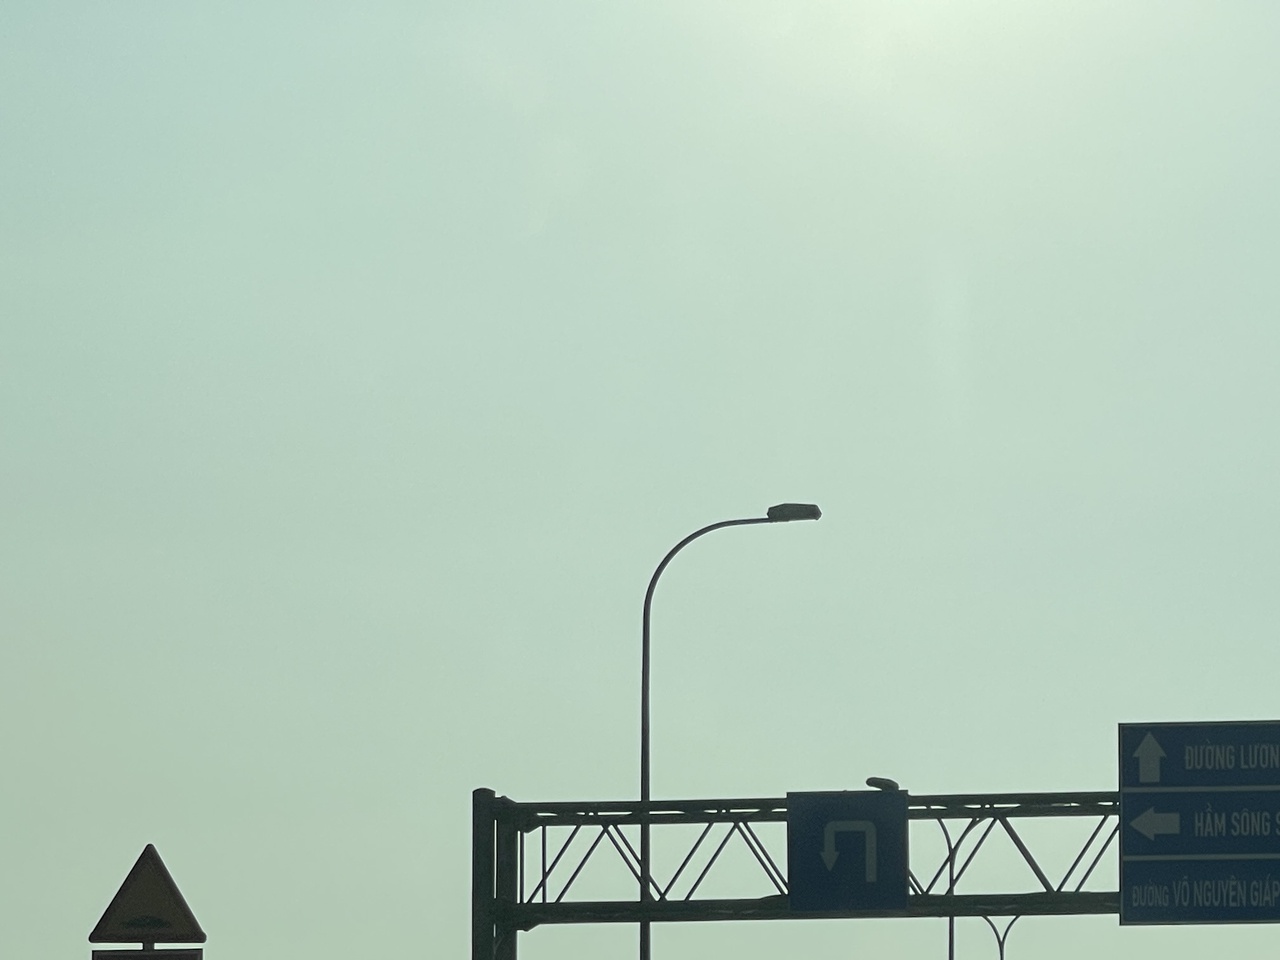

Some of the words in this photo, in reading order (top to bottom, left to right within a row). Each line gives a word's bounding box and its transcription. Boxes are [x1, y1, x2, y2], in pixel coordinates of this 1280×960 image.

[1184, 739, 1235, 770] ĐƯỜNG
[1194, 803, 1226, 837] HẦM
[1231, 807, 1271, 836] SÔNG
[1132, 880, 1169, 907] ĐƯỜNG
[1172, 875, 1190, 907] VÕ
[1193, 874, 1247, 907] NGUYÊN
[1250, 872, 1280, 907] GIÁP
